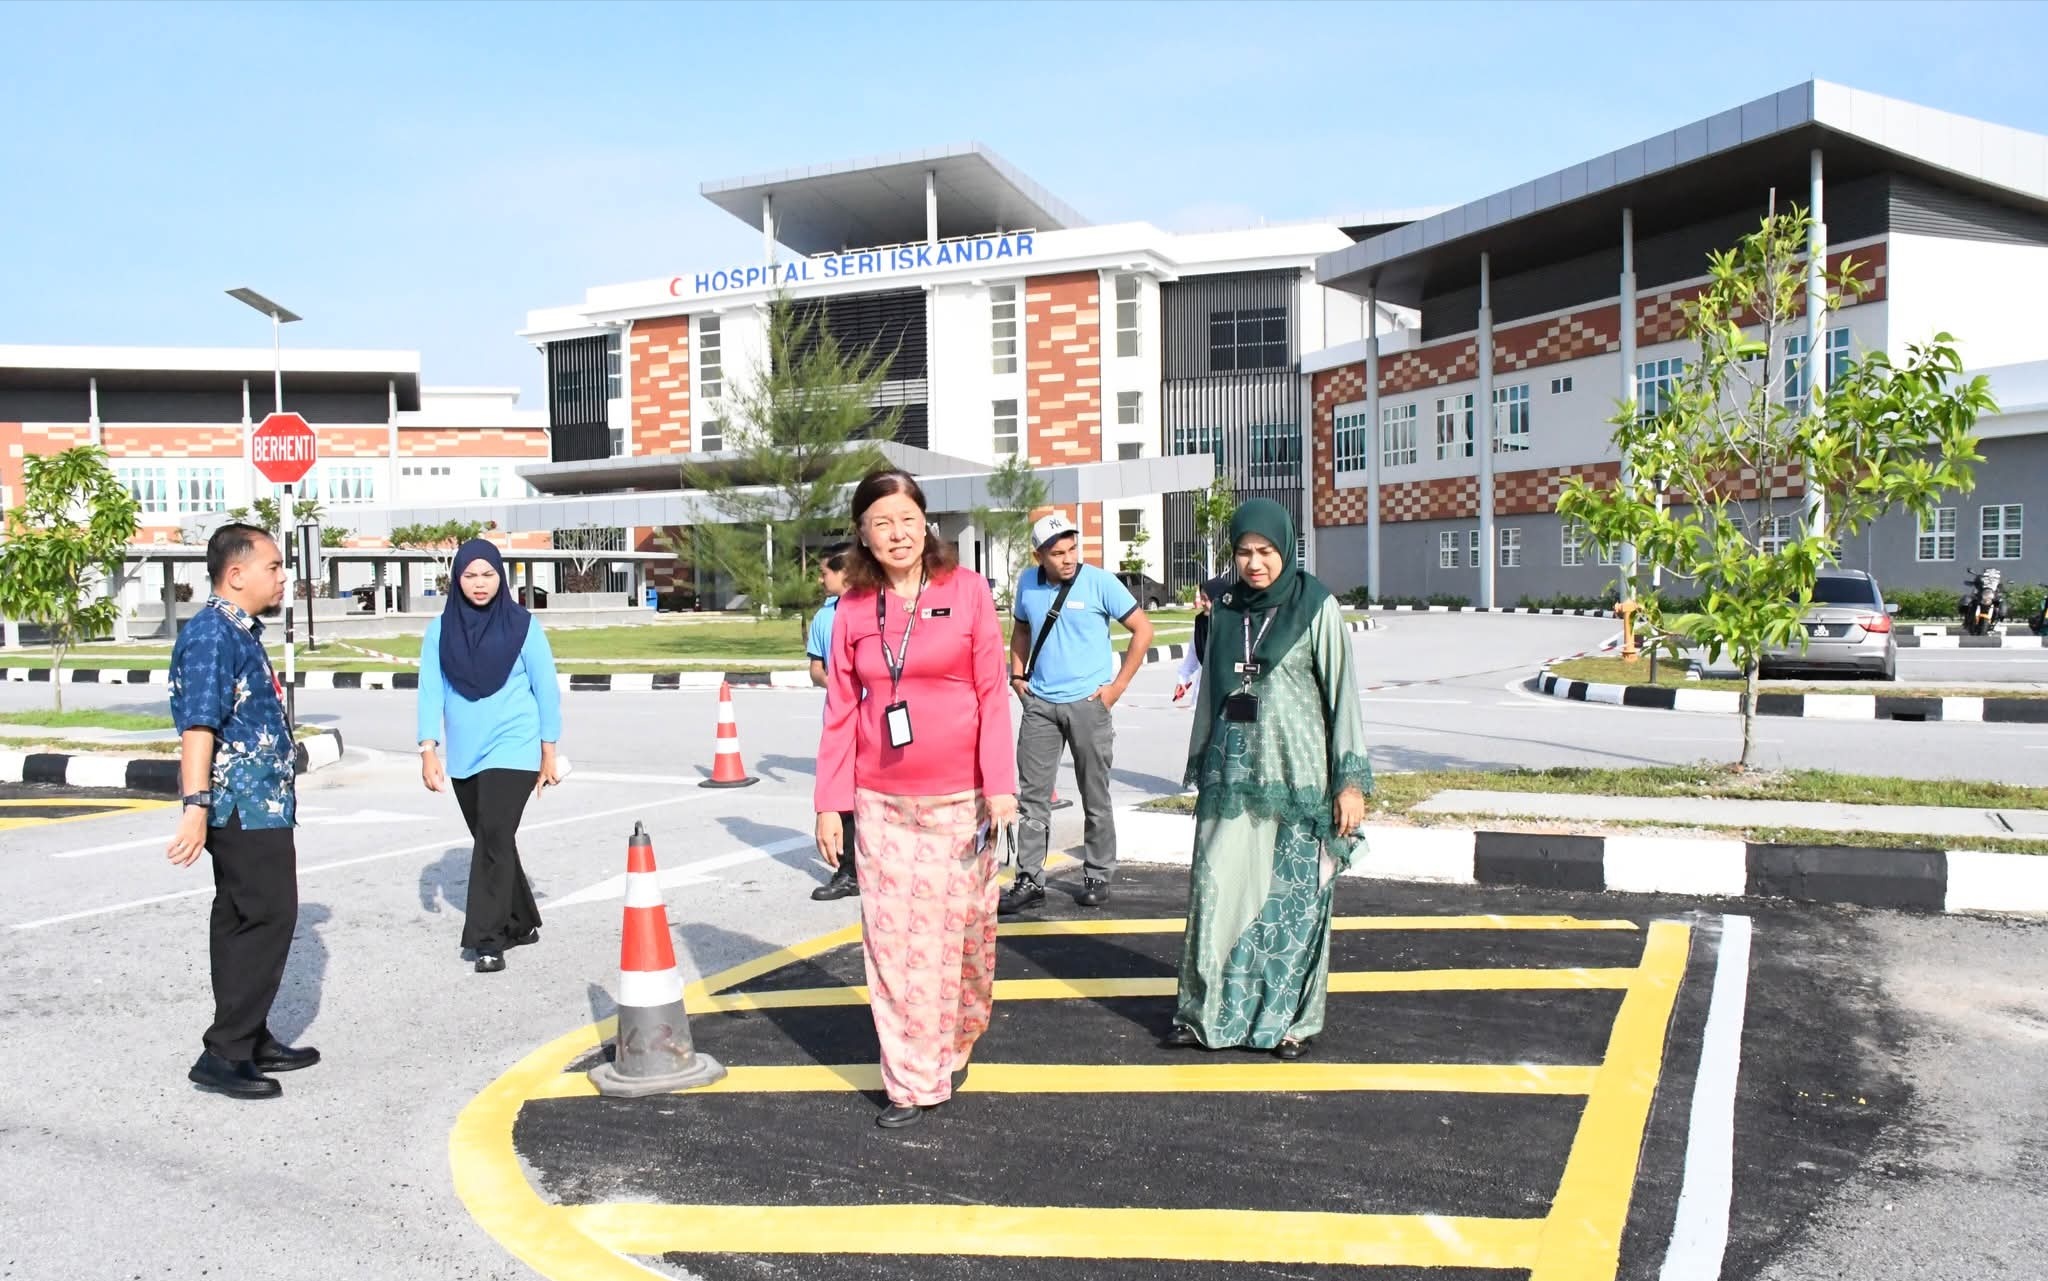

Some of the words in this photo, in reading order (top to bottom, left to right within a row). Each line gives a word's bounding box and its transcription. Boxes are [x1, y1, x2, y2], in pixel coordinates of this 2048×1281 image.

[695, 261, 814, 294] HOSPITAL
[824, 253, 882, 278] SERI
[891, 234, 1033, 271] ISKANDAR
[254, 435, 314, 462] BERHENTI
